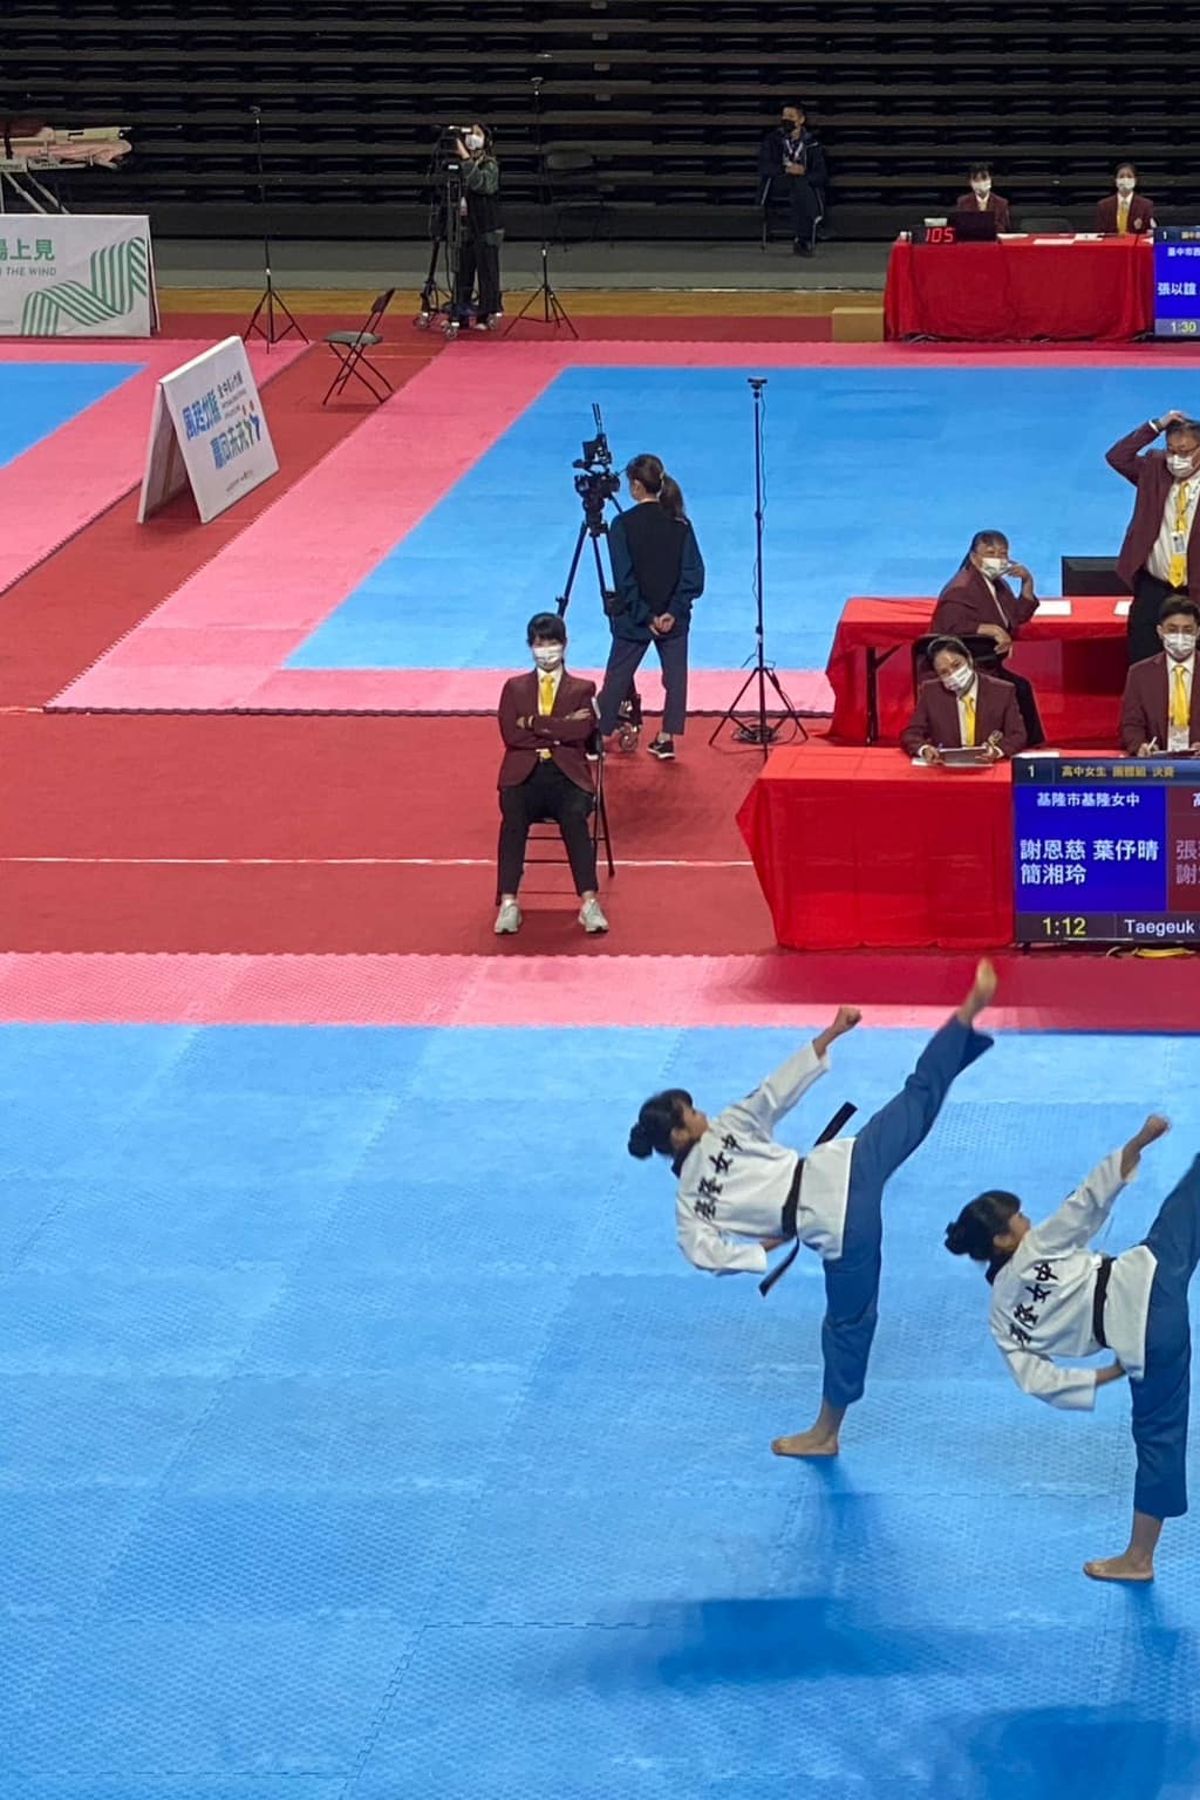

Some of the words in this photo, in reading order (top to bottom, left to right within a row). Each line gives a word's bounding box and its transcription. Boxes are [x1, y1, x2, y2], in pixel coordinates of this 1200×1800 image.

[6, 267, 26, 277] THE
[29, 267, 56, 277] WIND
[1171, 321, 1197, 333] 1:30
[1028, 765, 1035, 778] 1
[1062, 766, 1107, 778] 高中女生
[1037, 792, 1140, 807] 基隆市基隆女中
[1020, 839, 1086, 861] 謝恩慈
[1093, 839, 1159, 861] 葉伃晴
[1021, 863, 1087, 885] 簡湘玲
[1042, 917, 1087, 936] 1:12
[1124, 919, 1195, 937] Taegeuk
